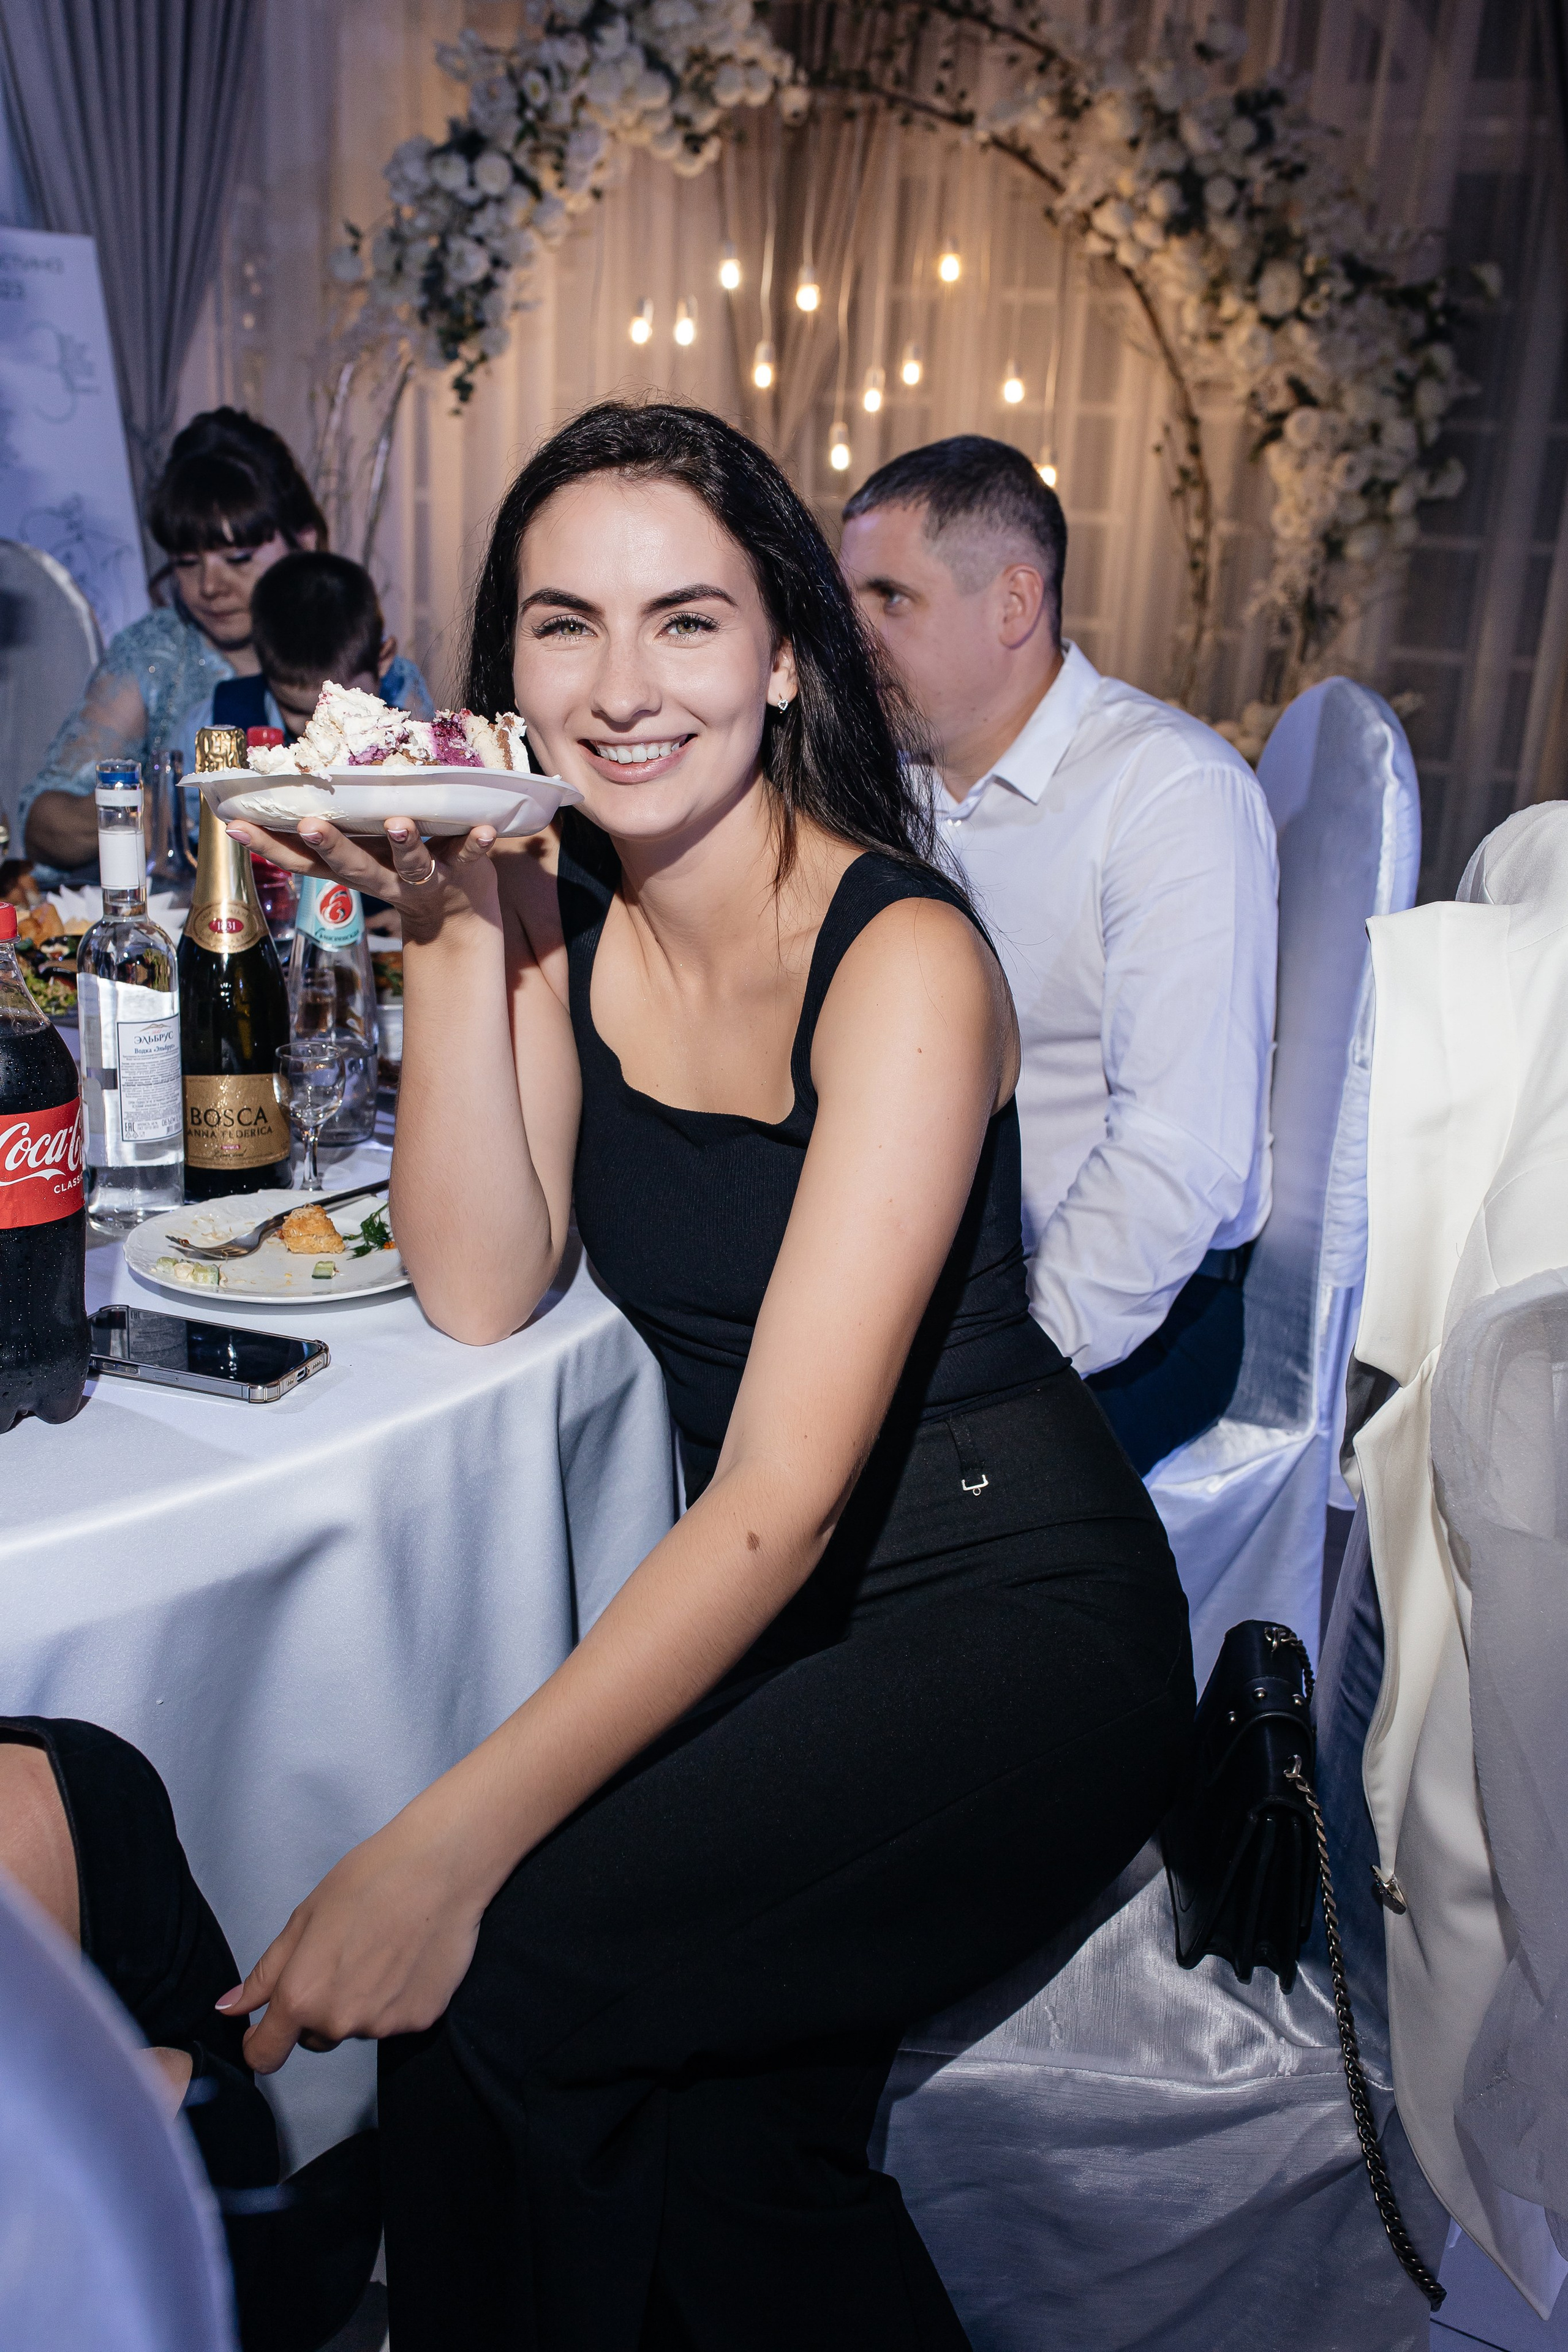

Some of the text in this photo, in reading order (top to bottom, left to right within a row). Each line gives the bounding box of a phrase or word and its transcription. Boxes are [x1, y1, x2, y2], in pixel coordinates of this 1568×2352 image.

[217, 921, 236, 931] 131
[134, 1031, 173, 1045] ЭЛЬБРУС
[190, 1106, 268, 1128] BOSCA
[187, 1129, 217, 1139] ANNA
